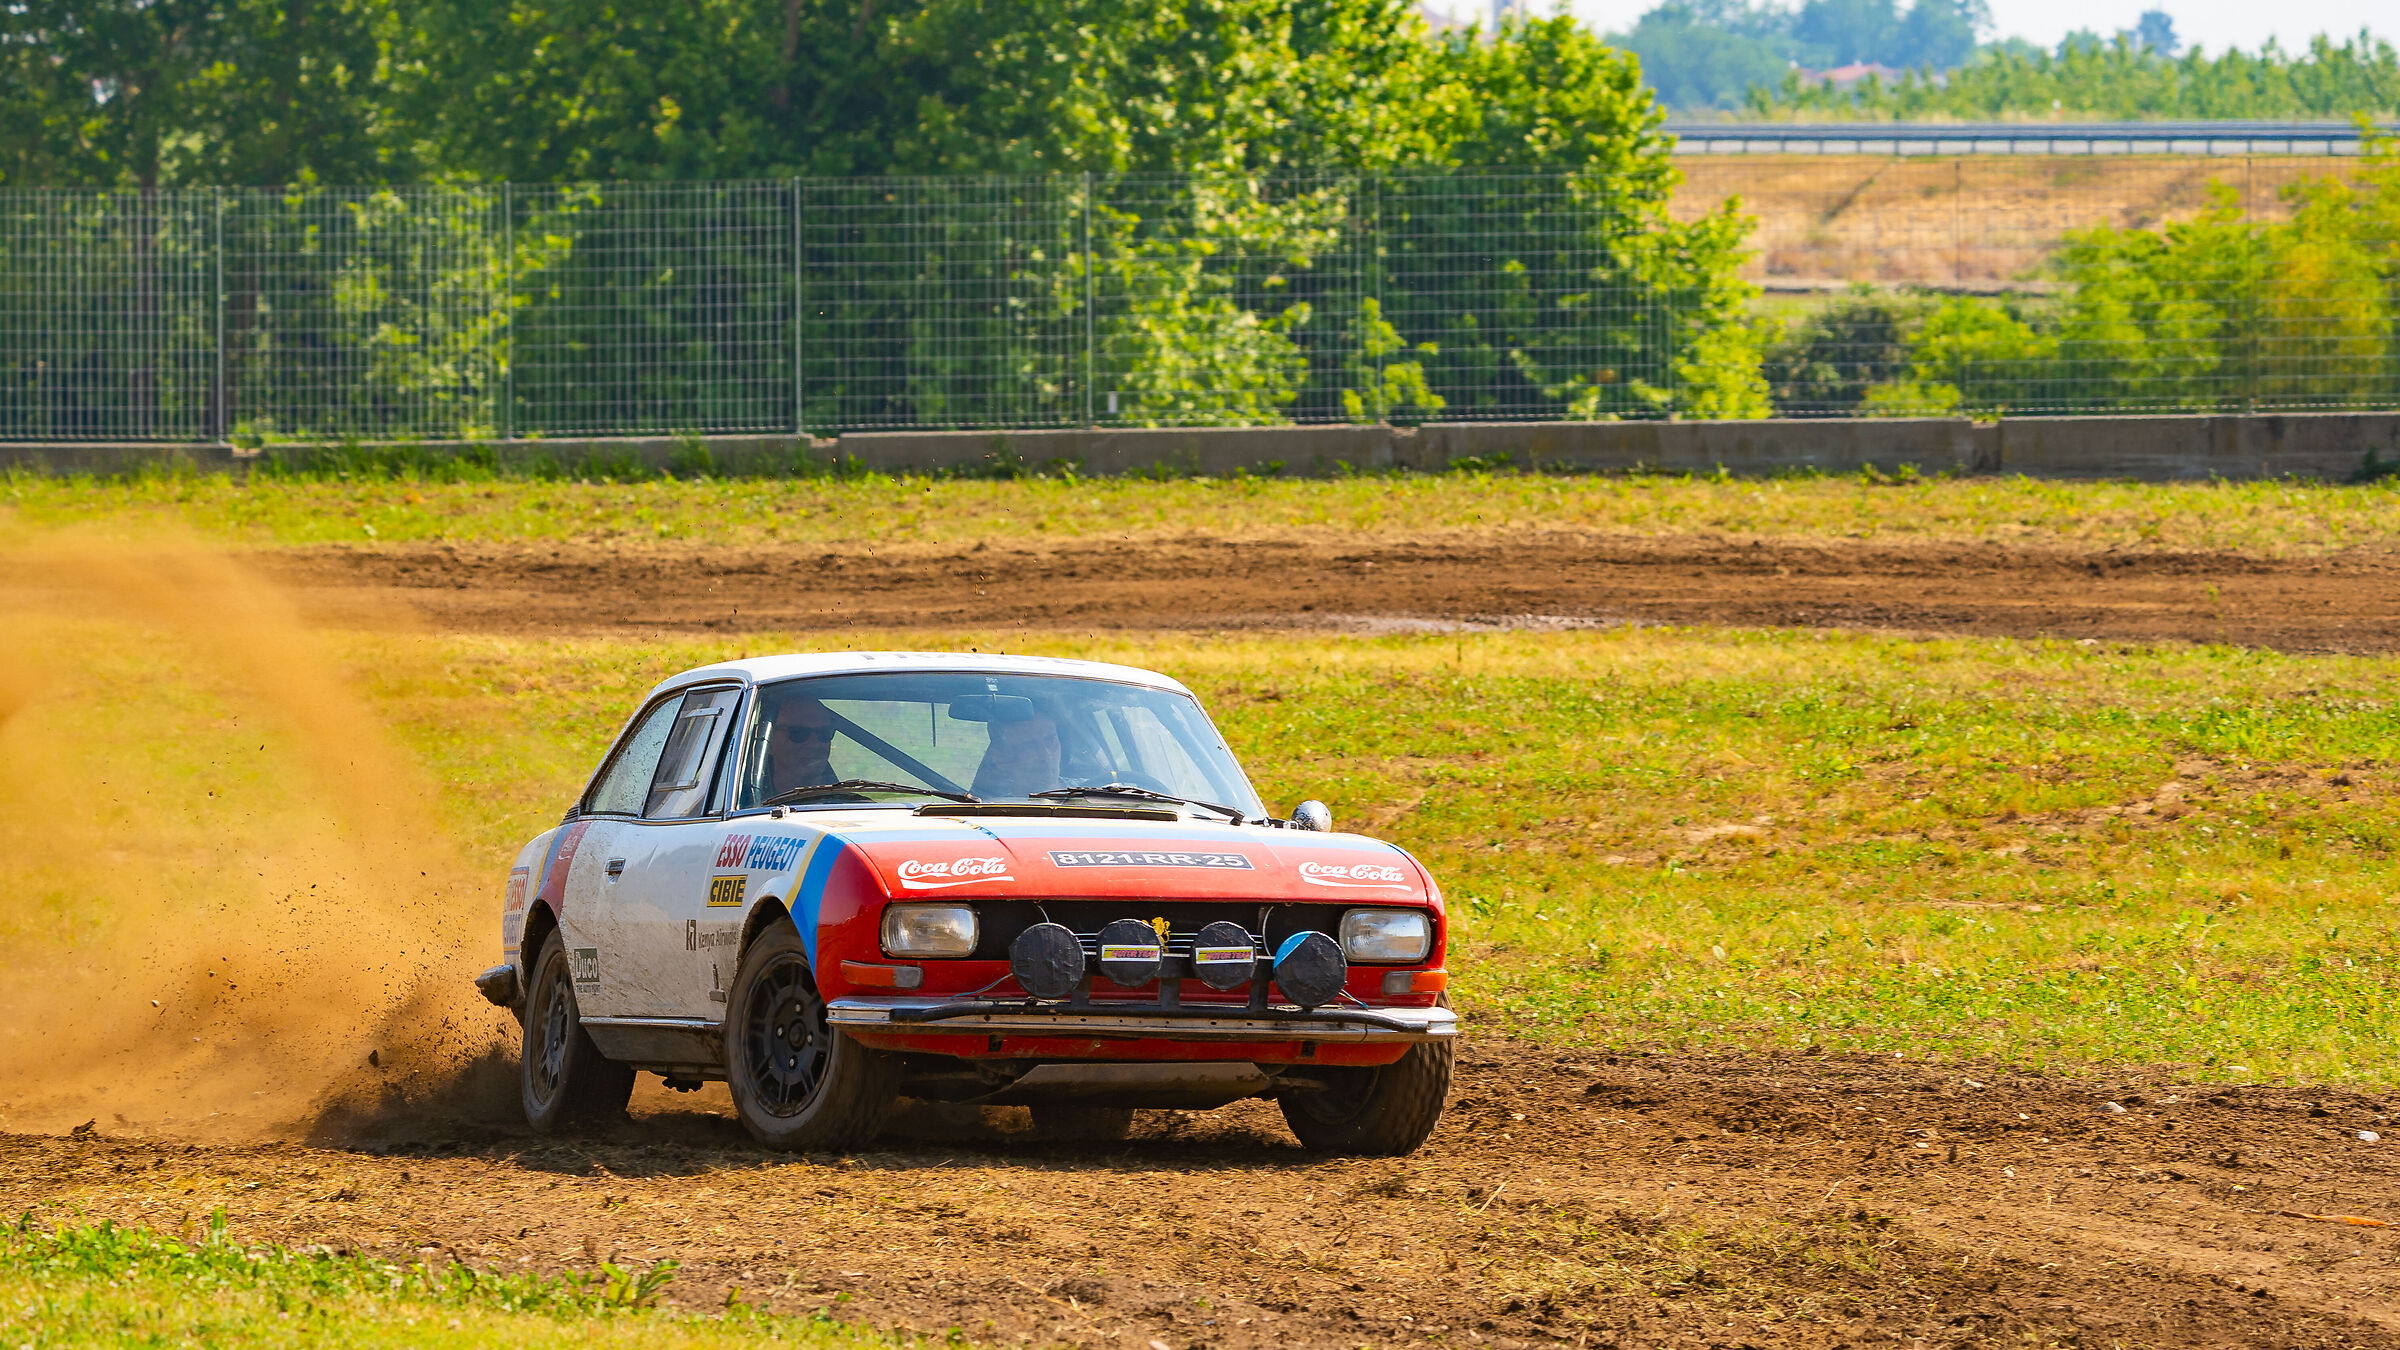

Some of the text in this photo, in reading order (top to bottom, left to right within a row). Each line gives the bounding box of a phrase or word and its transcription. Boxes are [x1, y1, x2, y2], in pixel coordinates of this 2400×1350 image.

[716, 834, 807, 872] ESSO PEUGEOT
[897, 857, 1007, 879] Coca Cola
[1298, 861, 1405, 882] Coca Cola
